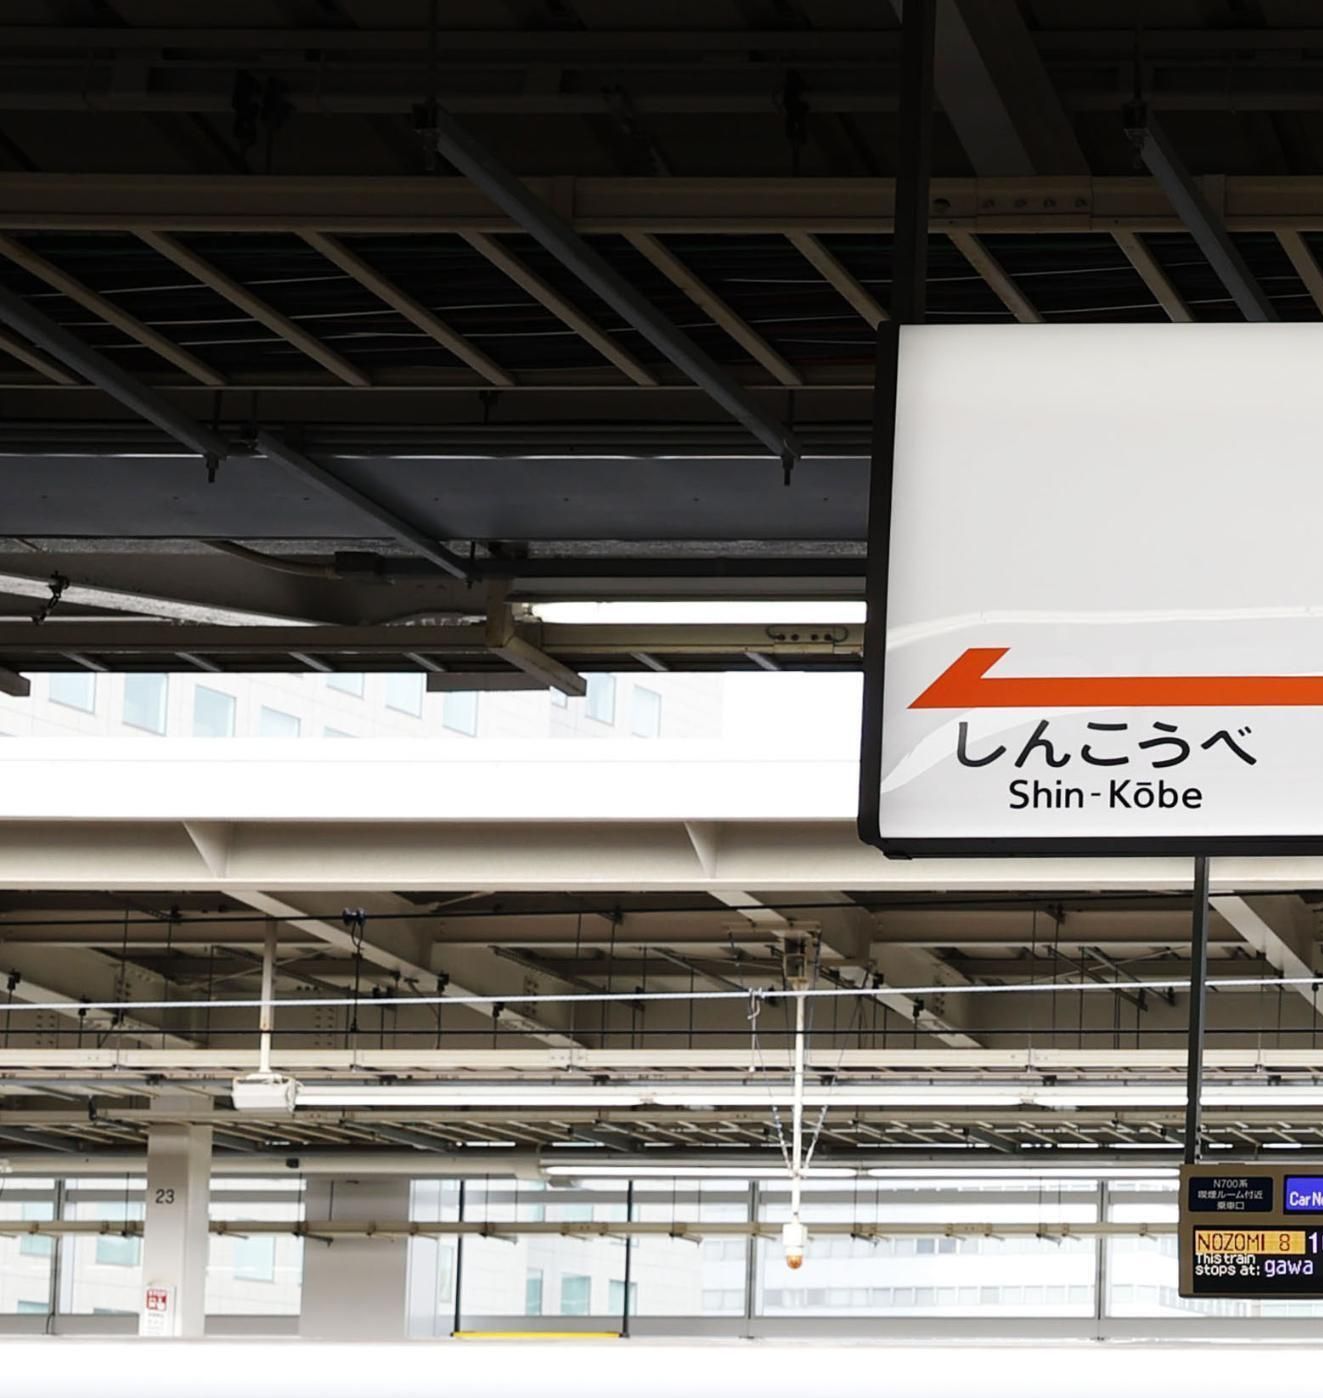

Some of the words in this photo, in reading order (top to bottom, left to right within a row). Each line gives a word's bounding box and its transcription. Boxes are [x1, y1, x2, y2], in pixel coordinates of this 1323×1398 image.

[954, 718, 1257, 771] しんこうべ
[1007, 775, 1205, 812] Shin-Kōbe
[155, 1189, 175, 1205] 23
[1289, 1191, 1311, 1206] Car
[1197, 1232, 1265, 1252] NOZOMI
[1279, 1233, 1291, 1252] 8
[1195, 1264, 1236, 1276] stops
[1240, 1265, 1260, 1276] at:
[1264, 1259, 1314, 1278] gawa
